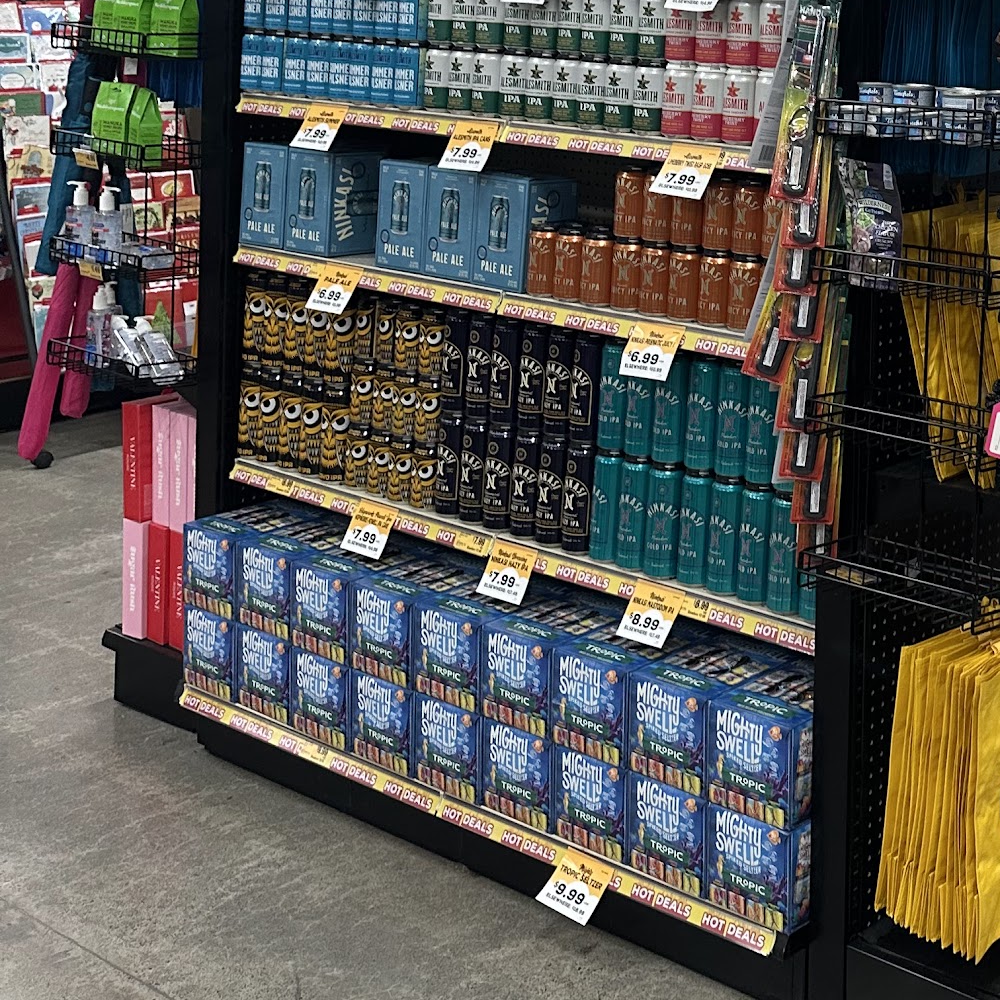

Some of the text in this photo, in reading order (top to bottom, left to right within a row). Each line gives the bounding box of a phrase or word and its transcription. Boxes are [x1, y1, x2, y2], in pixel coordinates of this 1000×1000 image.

[760, 24, 782, 36] ALESMI
[640, 35, 655, 45] IPA
[580, 101, 596, 112] IPA
[303, 128, 327, 139] $7.99
[507, 132, 560, 147] HOT DEALS
[451, 147, 477, 159] $7.99
[665, 172, 695, 185] $7.99
[333, 168, 354, 242] NINKASI
[247, 220, 275, 234] PALE ALE
[384, 243, 414, 257] PALE ALE
[481, 260, 513, 277] PALE ALE
[317, 288, 341, 301] $6.99
[444, 292, 491, 310] HOT DEALS
[504, 304, 556, 322] HOT DEALS
[565, 315, 619, 334] HOT DEALS
[628, 351, 659, 365] $6.99
[352, 528, 376, 545] $7.99
[661, 542, 672, 550] IPA
[489, 571, 516, 588] $7.99
[557, 566, 609, 588] HOT DEALS
[421, 610, 457, 641] MIGHTY
[629, 612, 659, 631] $8.99
[421, 631, 457, 657] SWELL
[432, 664, 461, 682] TROPIC
[559, 656, 600, 691] MIGHTY
[559, 676, 600, 707] SWELL
[571, 714, 603, 734] TROPIC
[716, 709, 763, 747] MIGHTY
[716, 731, 763, 764] SWELL
[729, 771, 766, 793] TROPIC
[384, 782, 432, 810] HOT DEALS
[636, 780, 680, 815] MIGHTY
[443, 807, 494, 836] HOT DEALS
[636, 802, 680, 833] SWELL
[650, 841, 683, 861] TROPIC
[560, 864, 602, 891] TROPIC SELTZER
[554, 880, 586, 905] $9.99
[631, 884, 691, 917] HOT DEALS
[702, 913, 765, 947] HOT DEALS
